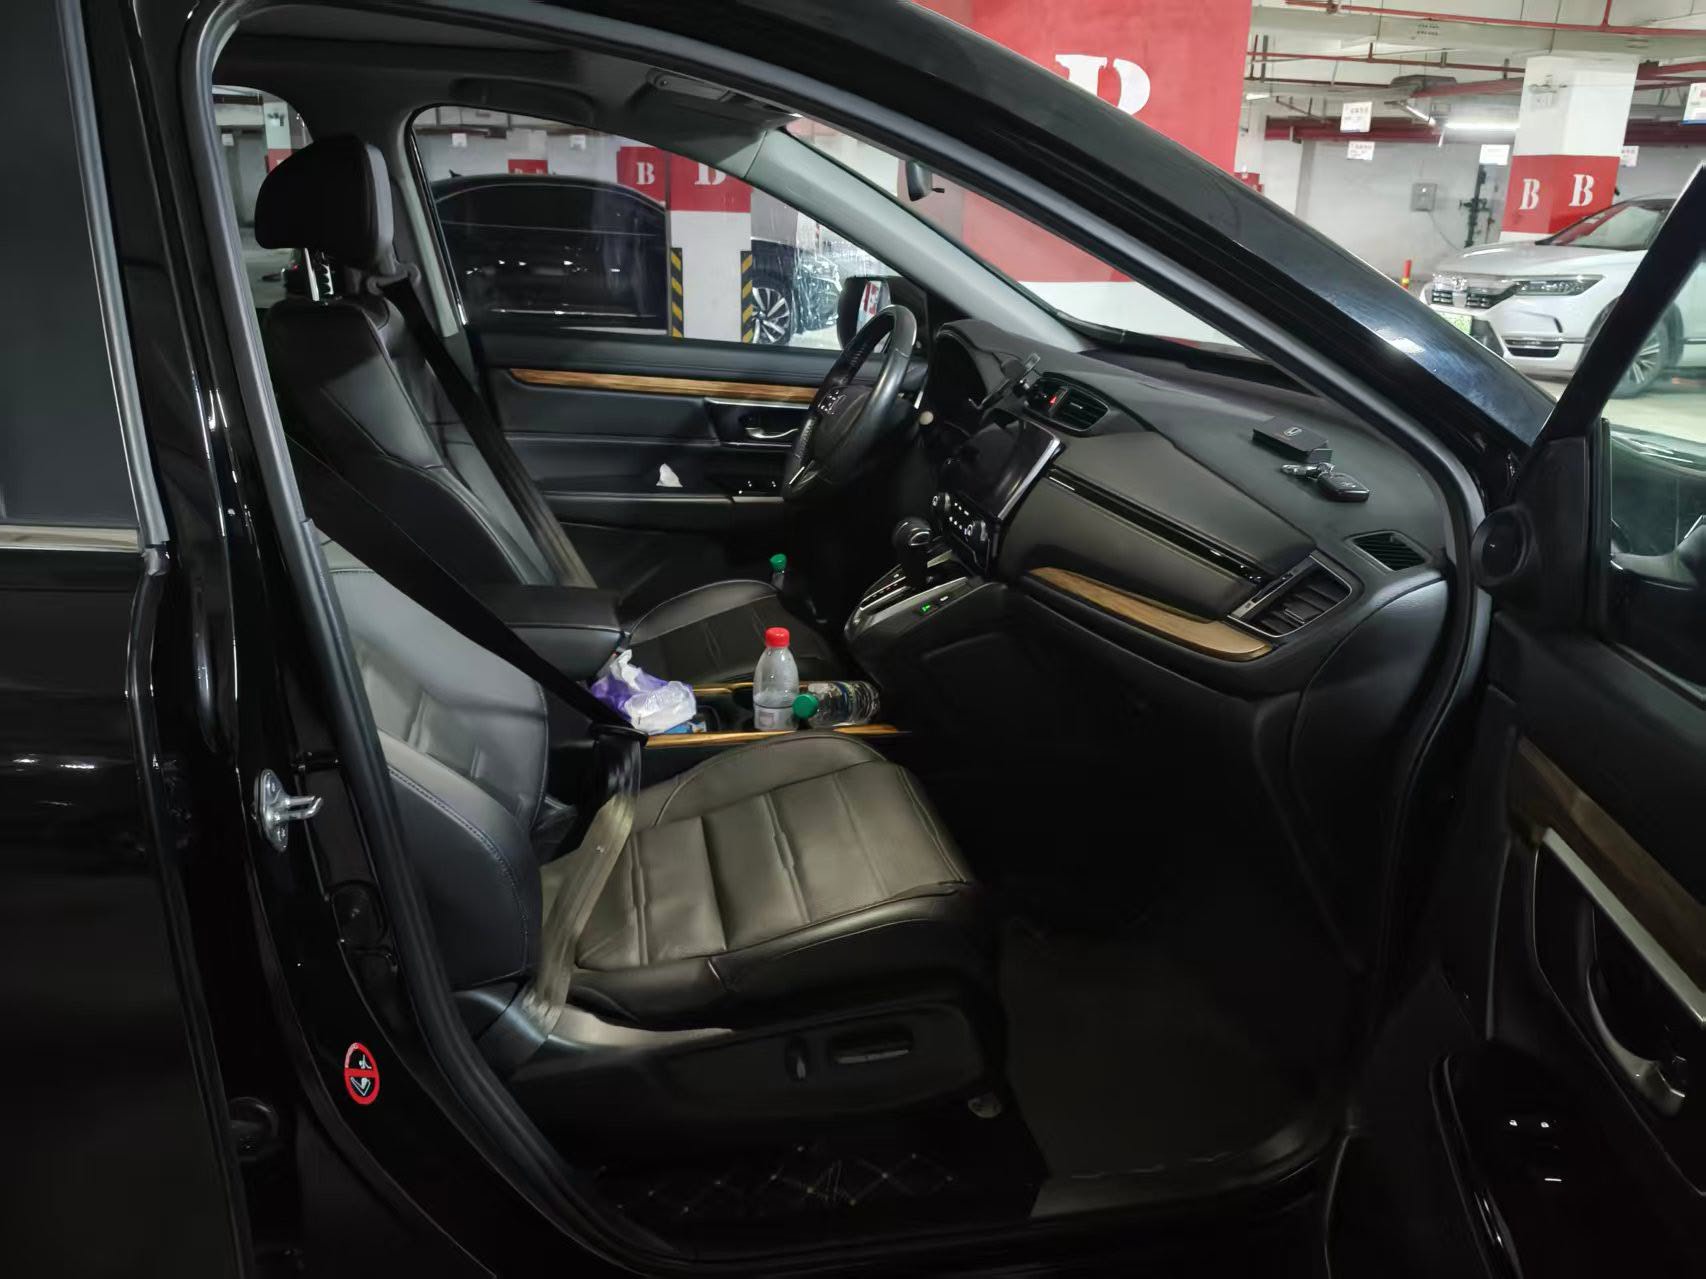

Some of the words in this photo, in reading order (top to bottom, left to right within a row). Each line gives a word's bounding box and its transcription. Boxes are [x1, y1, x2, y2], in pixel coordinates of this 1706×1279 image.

[636, 162, 656, 185] B
[1518, 178, 1541, 210] B
[1569, 174, 1595, 207] B
